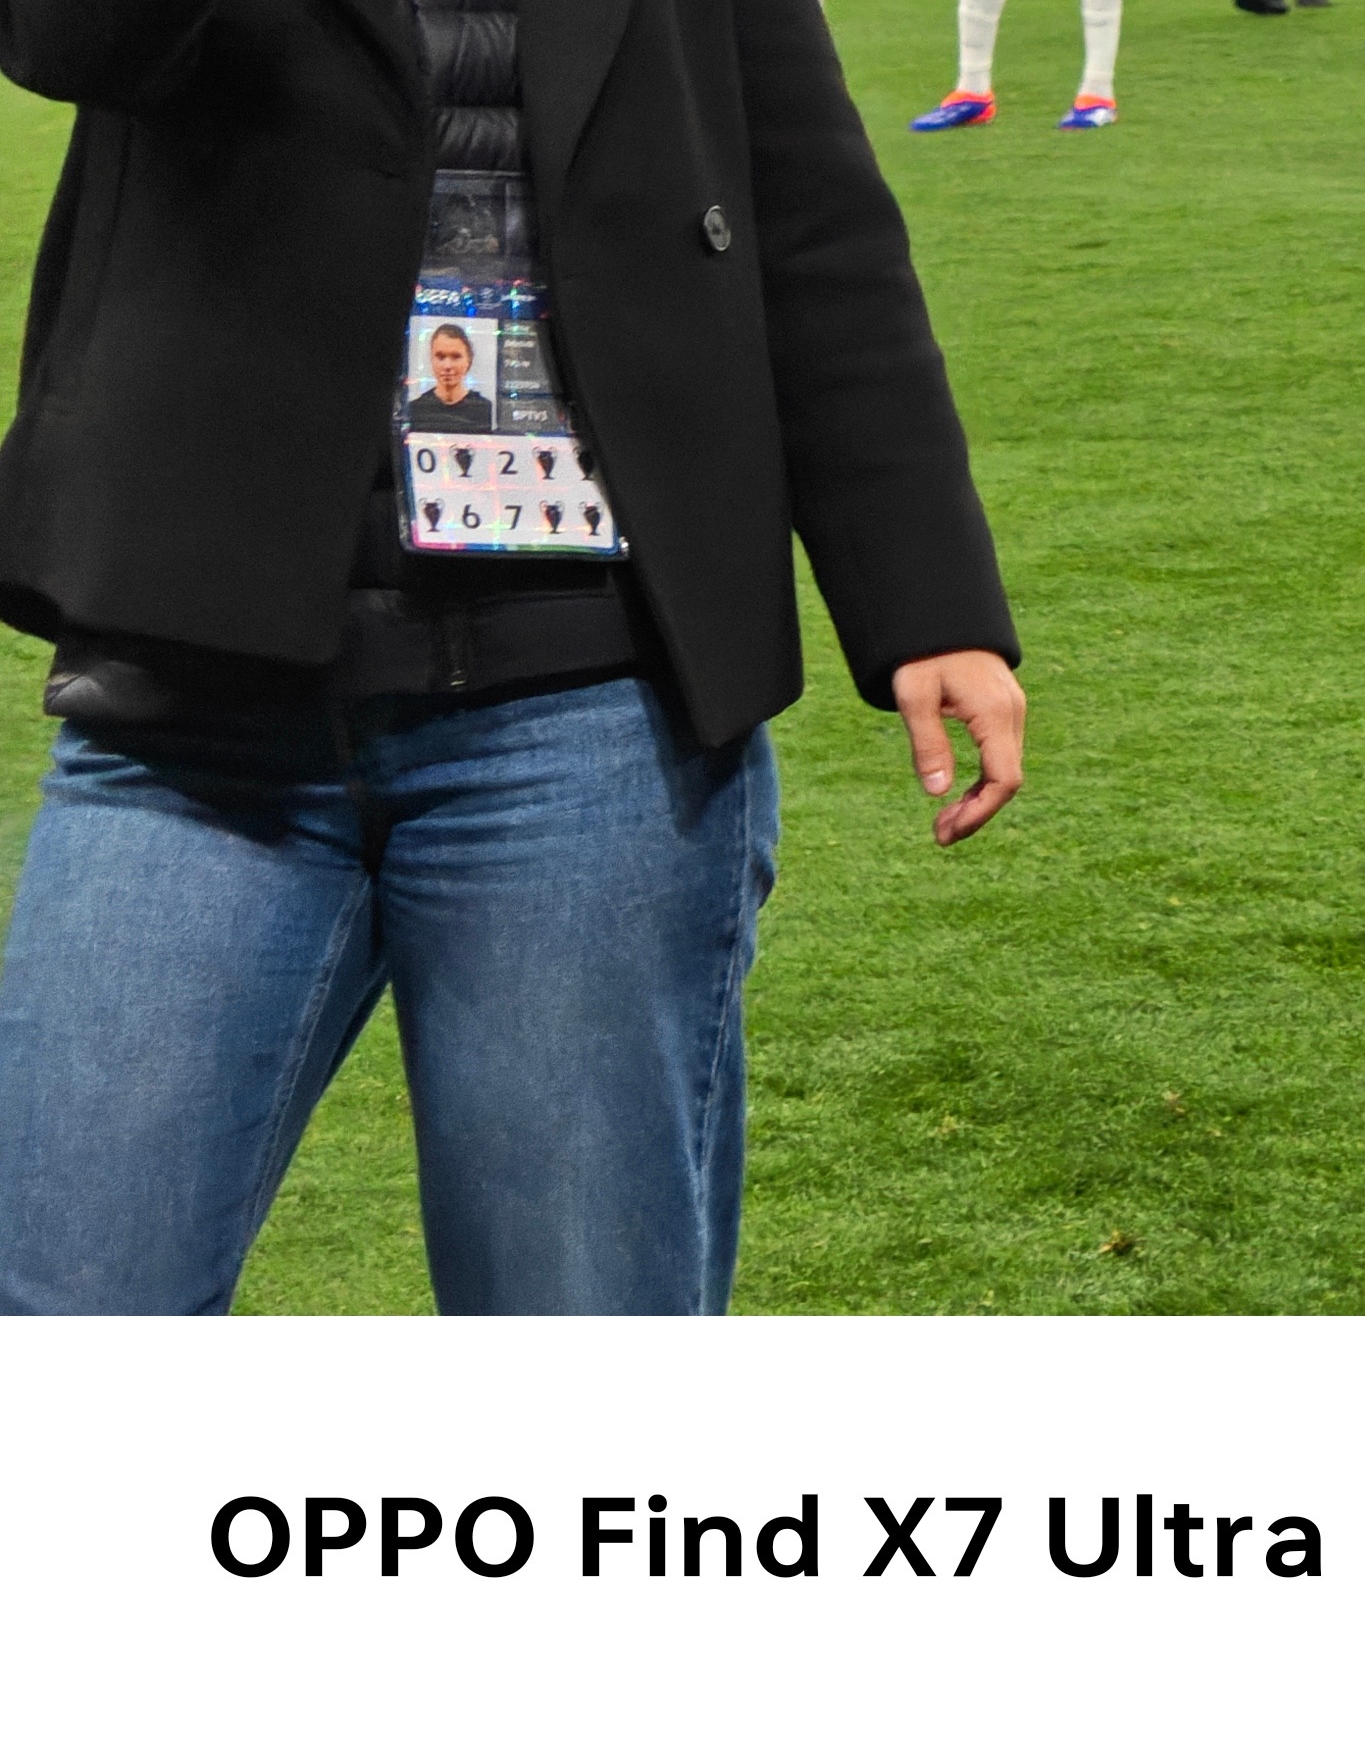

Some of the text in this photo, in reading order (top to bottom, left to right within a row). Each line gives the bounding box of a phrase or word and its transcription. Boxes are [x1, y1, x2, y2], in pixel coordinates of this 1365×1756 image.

[416, 448, 518, 475] 0 2
[461, 503, 523, 530] 6 7
